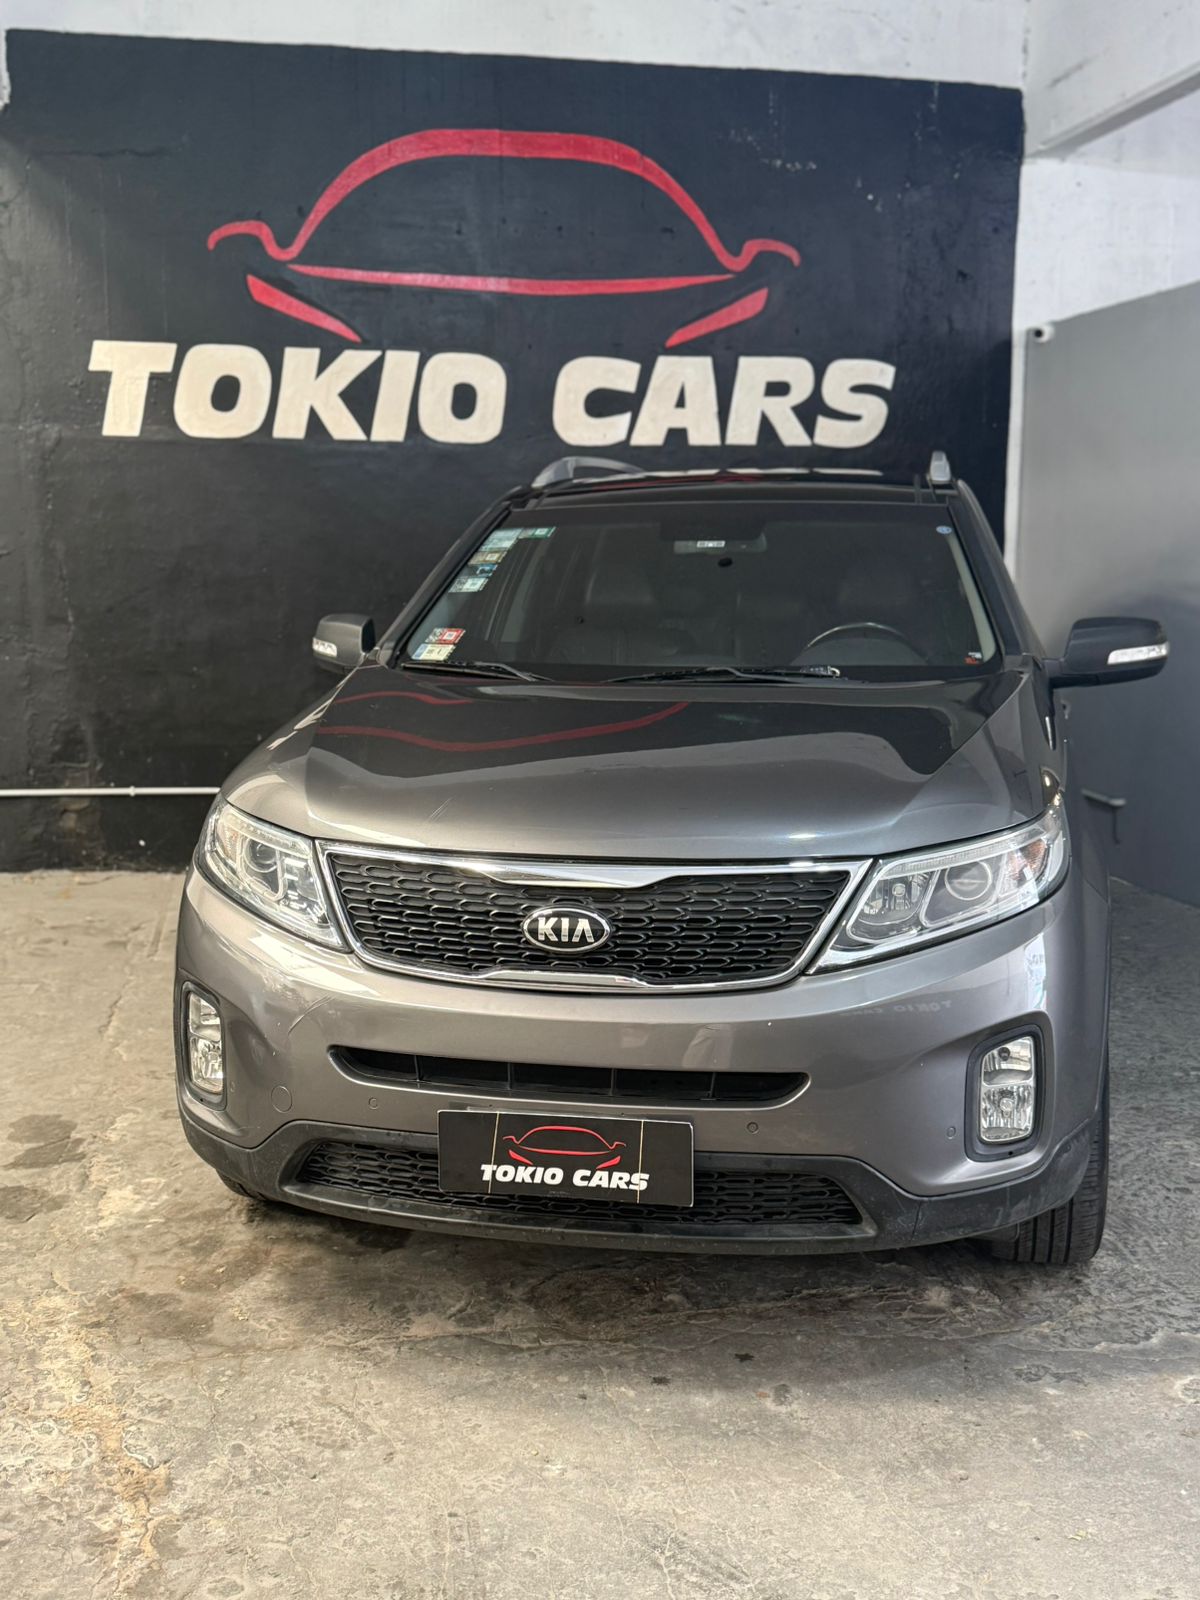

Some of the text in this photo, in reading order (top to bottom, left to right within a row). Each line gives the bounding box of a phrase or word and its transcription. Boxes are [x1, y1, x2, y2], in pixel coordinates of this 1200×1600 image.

[88, 339, 897, 449] TOKIO CARS
[537, 916, 595, 943] KIA
[480, 1164, 650, 1191] TOKIO CARS
